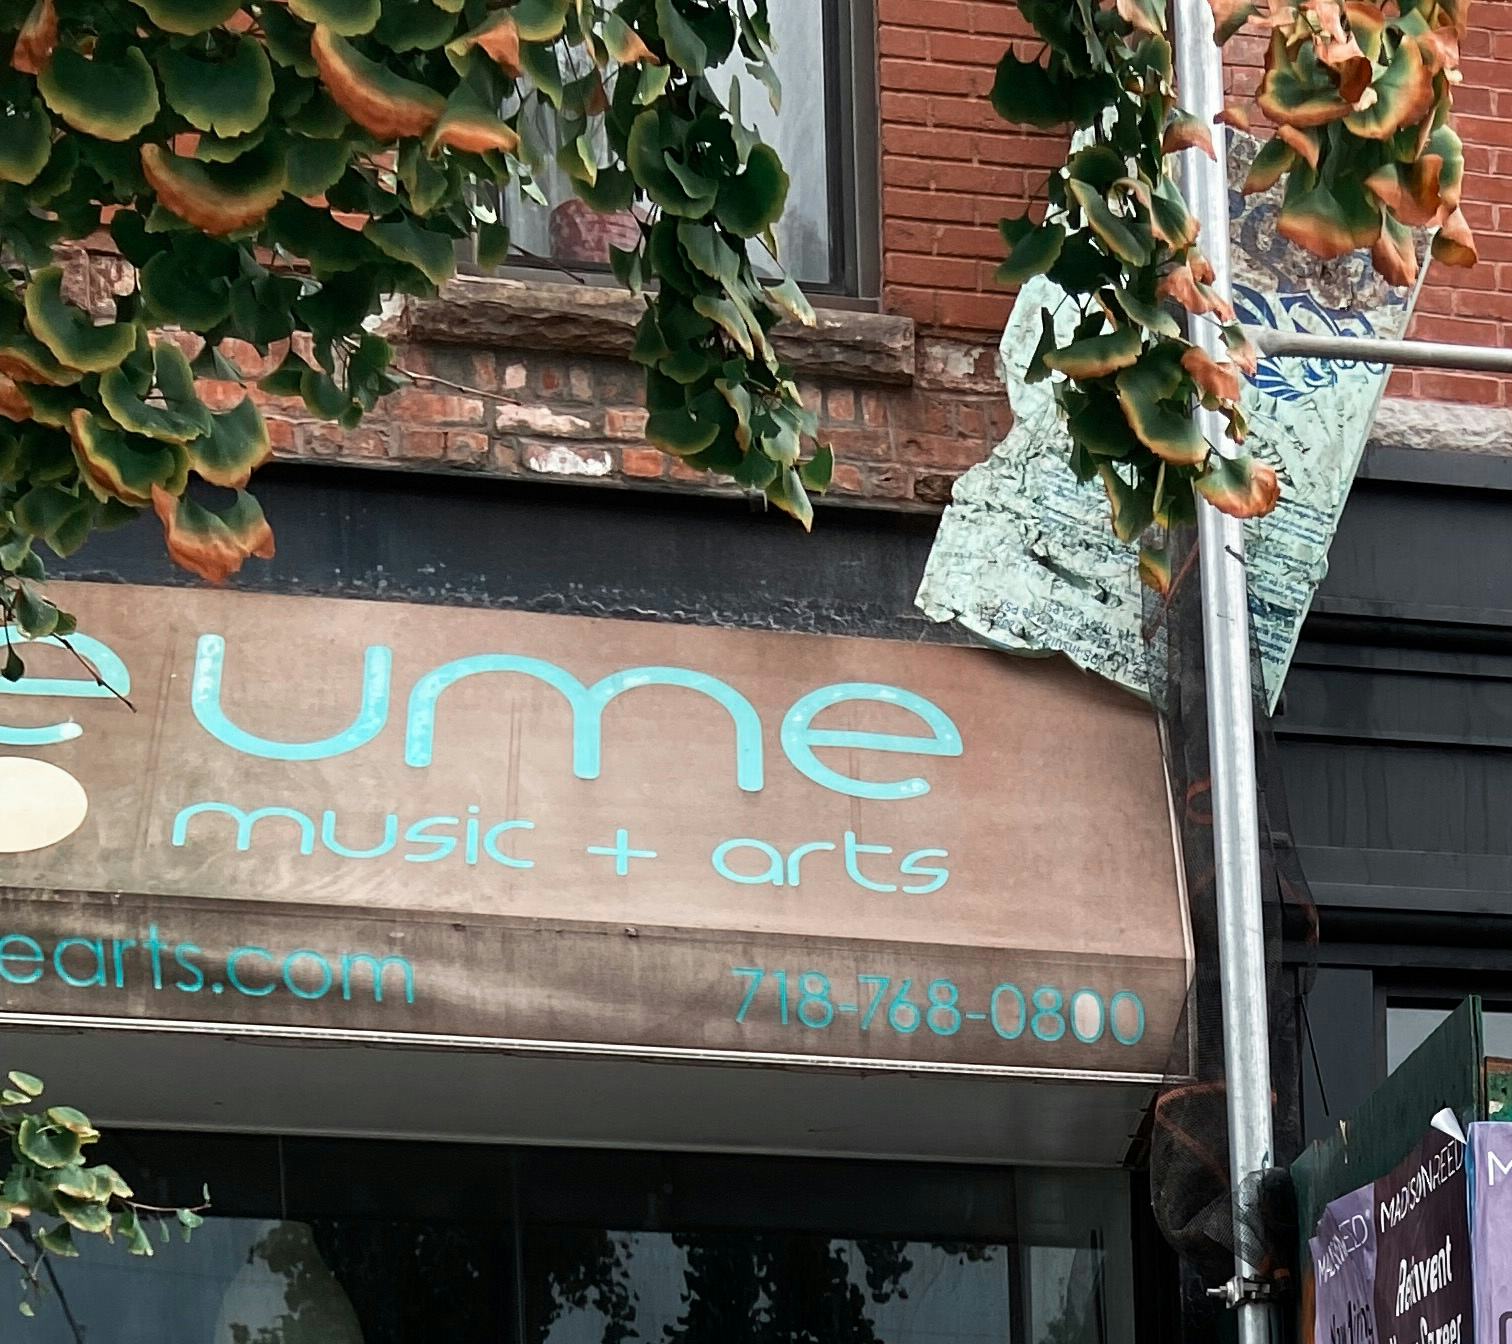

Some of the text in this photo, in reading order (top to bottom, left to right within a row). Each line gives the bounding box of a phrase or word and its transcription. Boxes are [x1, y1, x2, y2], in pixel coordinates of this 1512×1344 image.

[172, 801, 536, 868] music
[711, 830, 950, 894] arts
[731, 966, 1146, 1046] 718-768-0800
